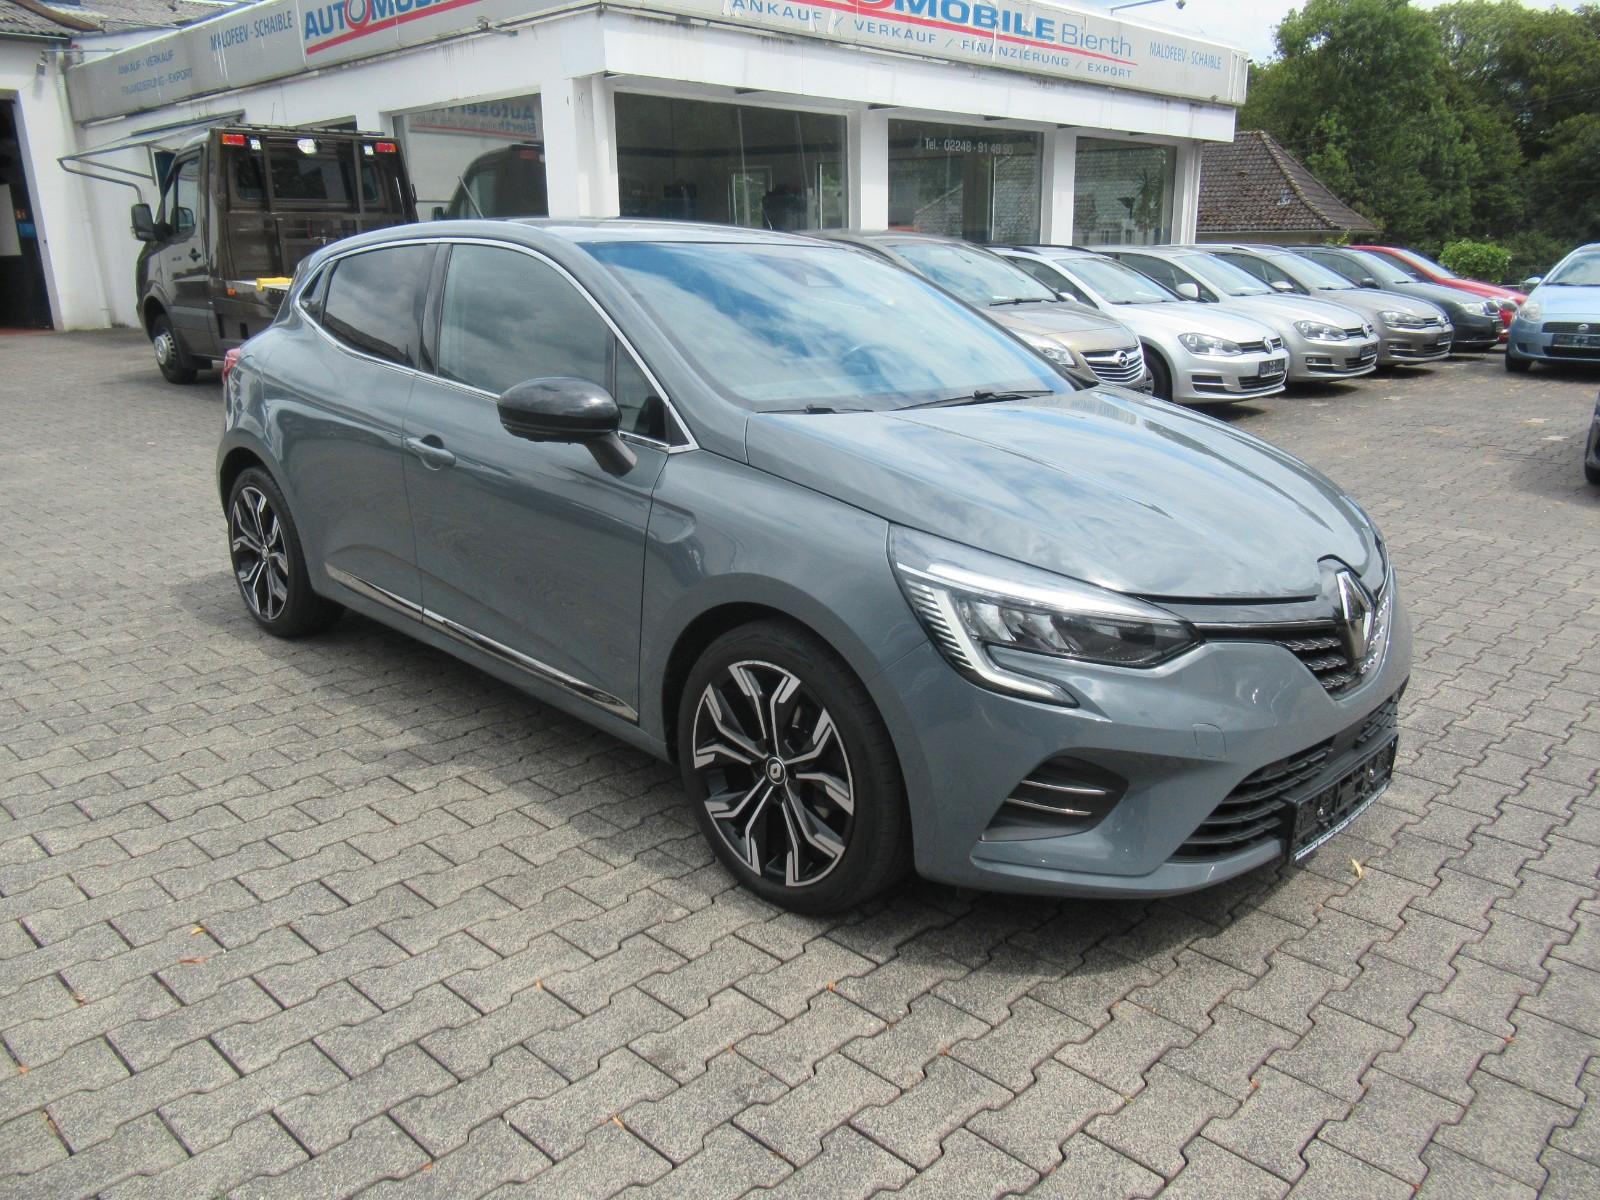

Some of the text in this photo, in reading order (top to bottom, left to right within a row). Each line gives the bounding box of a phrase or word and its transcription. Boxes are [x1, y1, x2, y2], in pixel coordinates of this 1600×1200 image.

[210, 23, 249, 51] MALOFEEV
[254, 10, 294, 38] SCHAIBLE
[304, 0, 442, 40] AUTOM
[732, 0, 823, 21] ANKAUF
[854, 19, 937, 44] VERKAUF
[962, 39, 1069, 68] FINANZIERUNG
[1088, 62, 1132, 79] EXPORT
[1062, 23, 1132, 57] Bierth
[1149, 41, 1187, 63] MALOFEEV
[1191, 50, 1222, 70] SCHAIBLE
[943, 139, 972, 153] 02248
